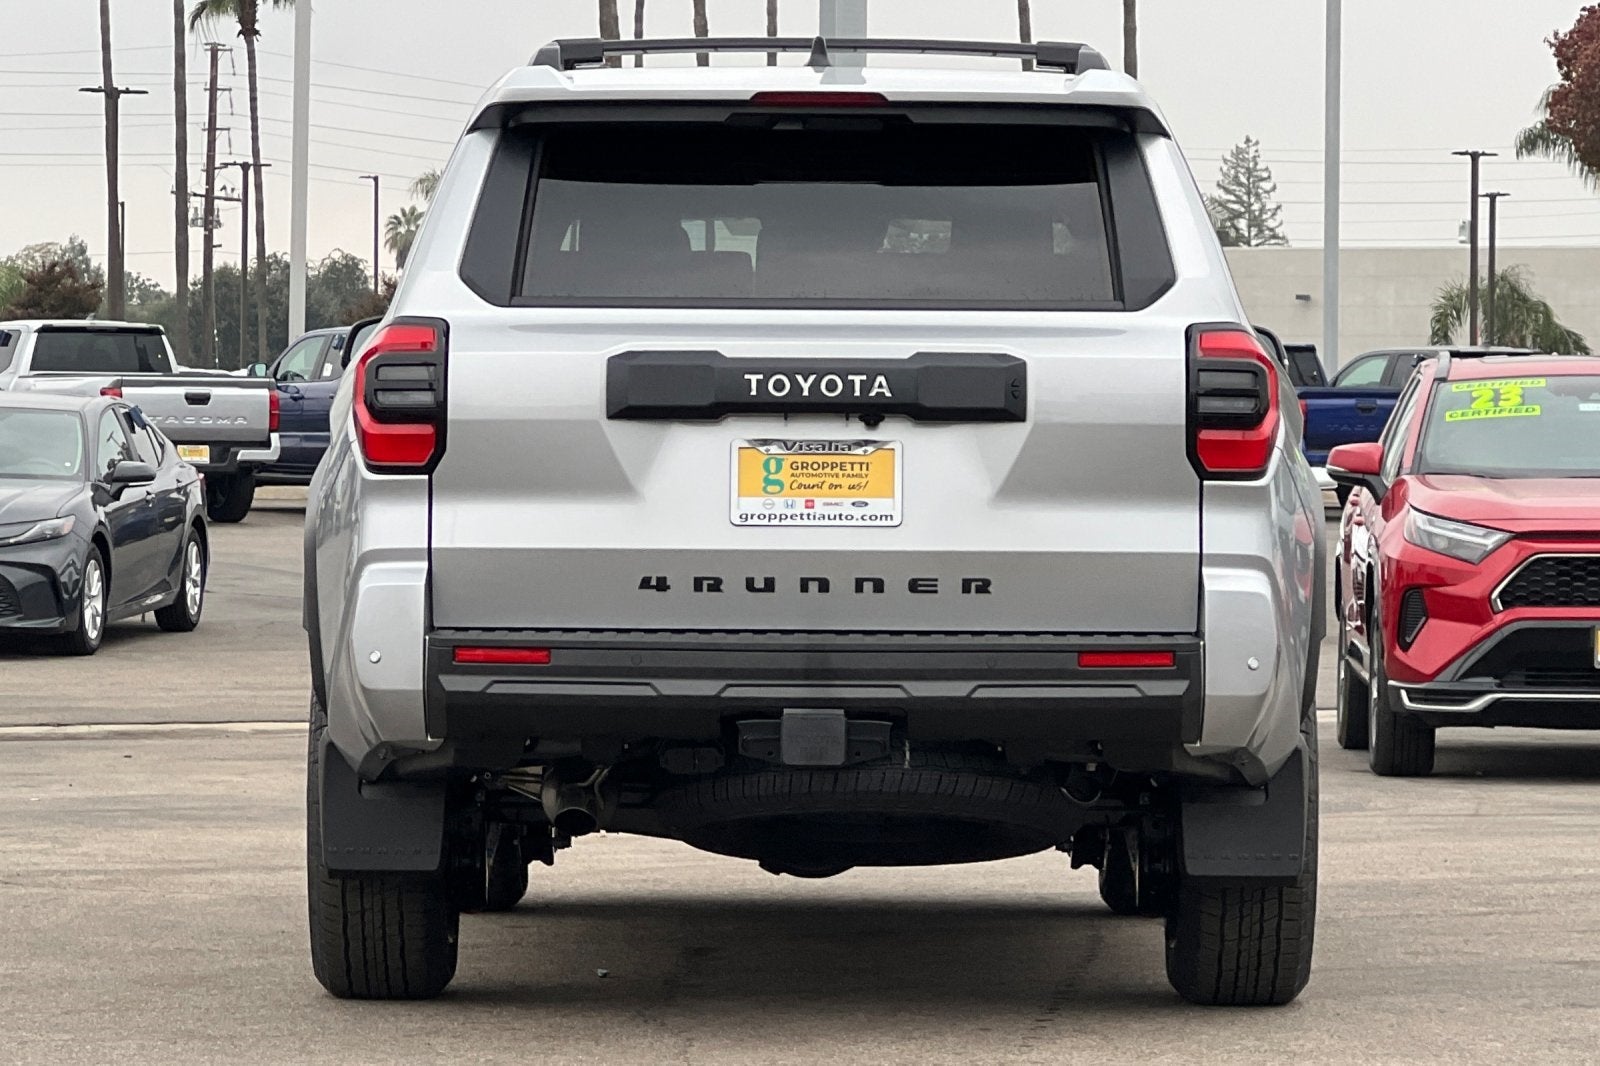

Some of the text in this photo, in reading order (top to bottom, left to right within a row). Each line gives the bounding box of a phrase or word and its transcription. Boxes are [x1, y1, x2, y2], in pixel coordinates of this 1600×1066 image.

[744, 373, 892, 398] TOYOTA
[1455, 379, 1542, 390] CERTIFIED
[1471, 385, 1524, 409] 23
[1448, 406, 1536, 419] CERTIFIED
[147, 415, 248, 425] TACOMA
[782, 440, 852, 452] Visalia
[789, 461, 870, 472] GROPPETTI
[789, 479, 826, 491] Count
[847, 480, 870, 491] us!
[739, 511, 894, 523] groppettiauto.com
[638, 575, 993, 595] 4RUNNER
